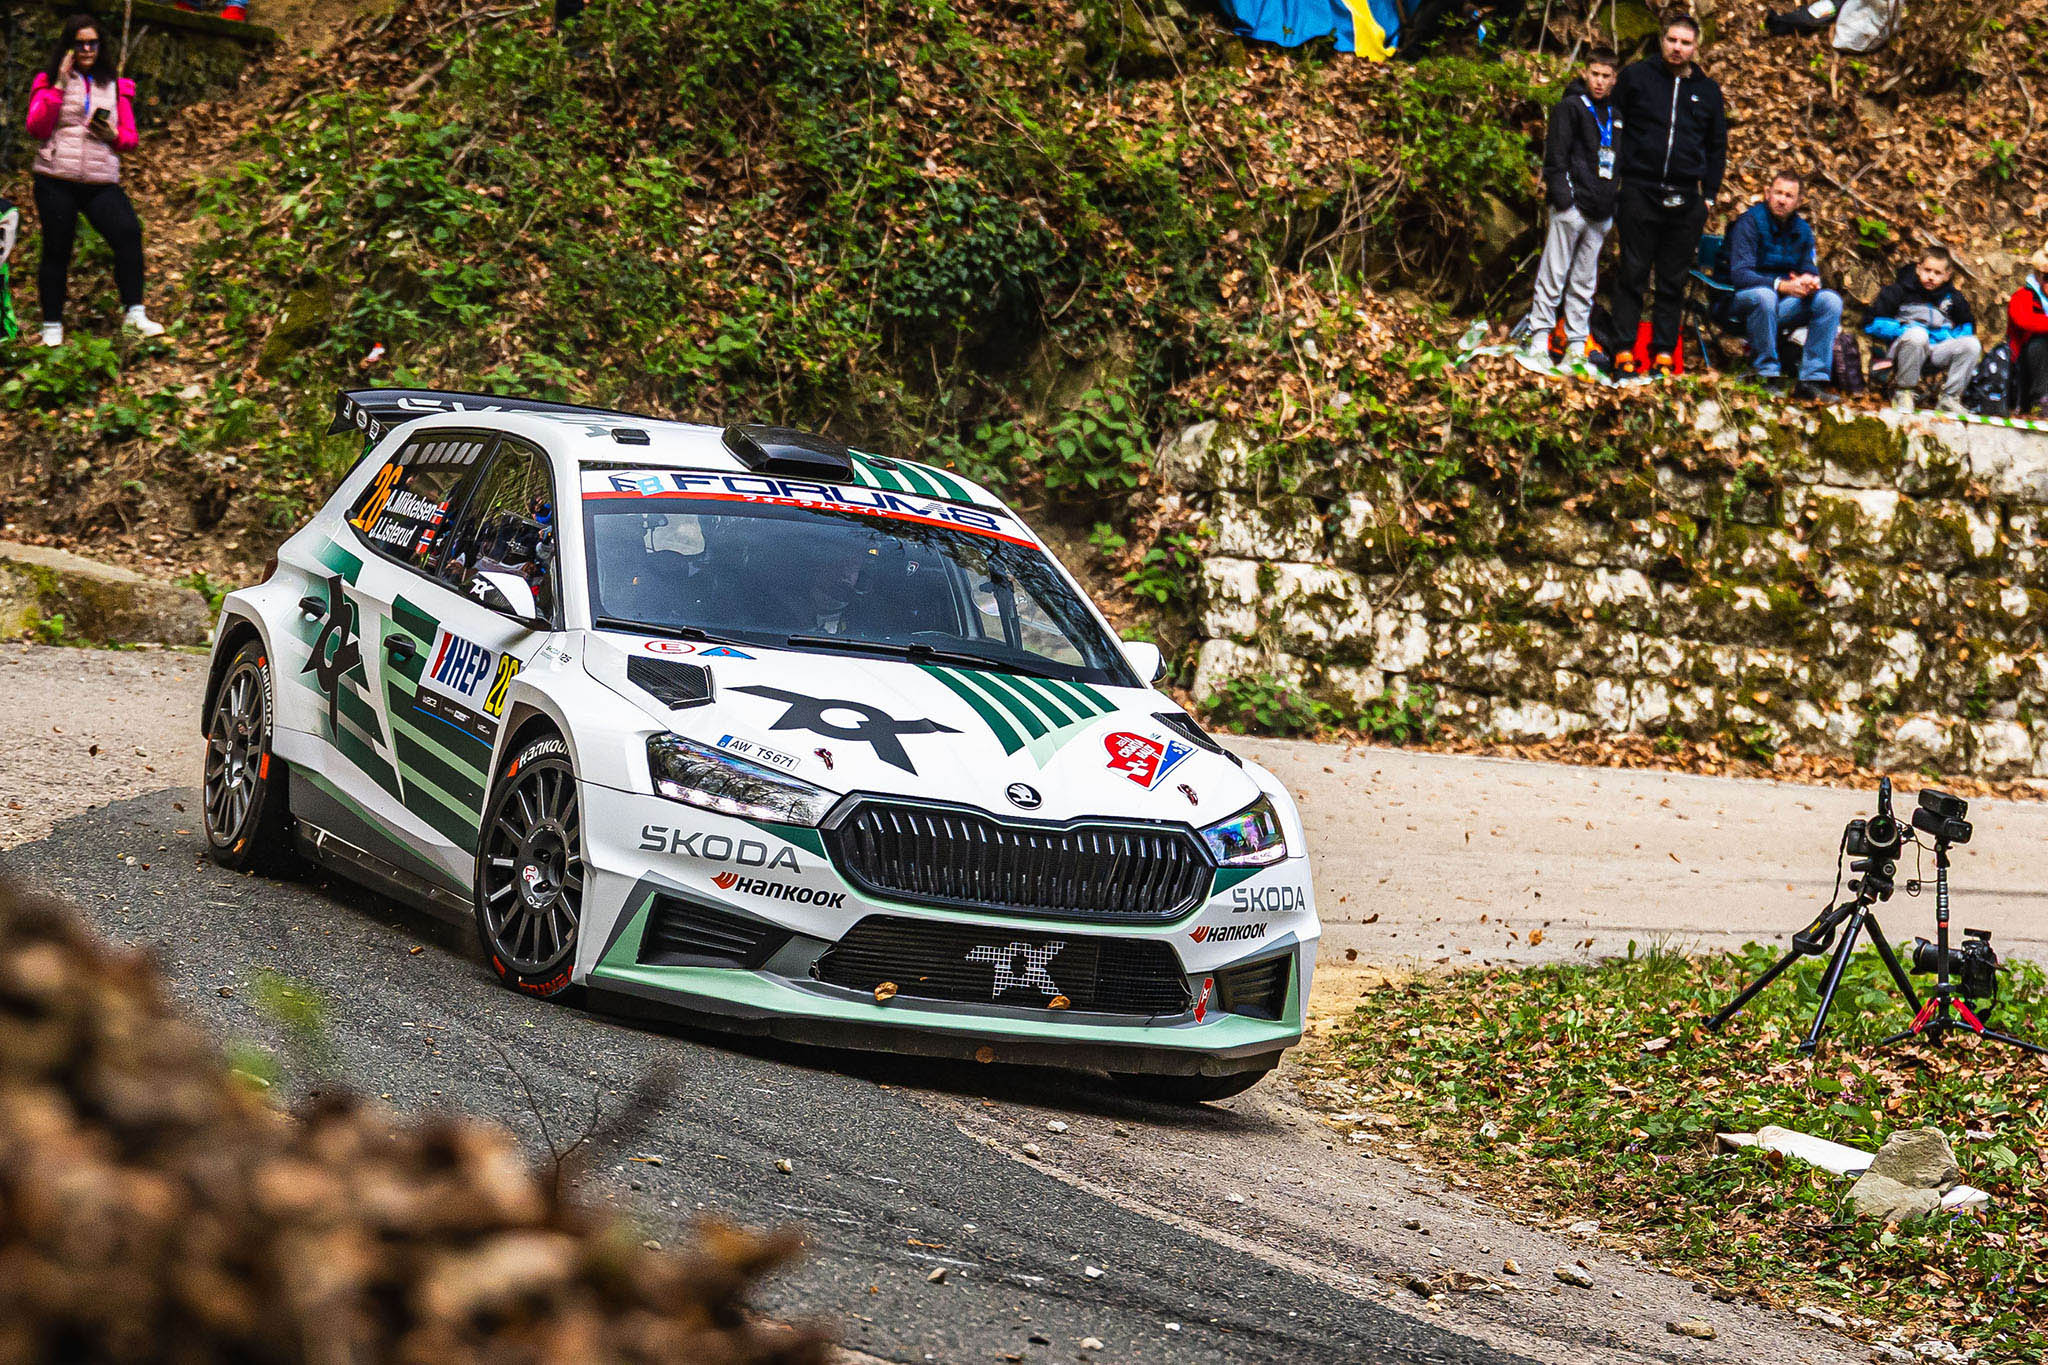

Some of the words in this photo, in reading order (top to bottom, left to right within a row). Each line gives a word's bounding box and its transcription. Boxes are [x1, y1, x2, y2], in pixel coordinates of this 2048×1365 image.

[349, 463, 404, 533] 26
[382, 489, 438, 521] A.Mikkelsen
[670, 473, 1001, 531] FORUM8
[368, 516, 418, 547] J.Listerud
[729, 740, 753, 752] AW
[757, 748, 794, 767] TS671
